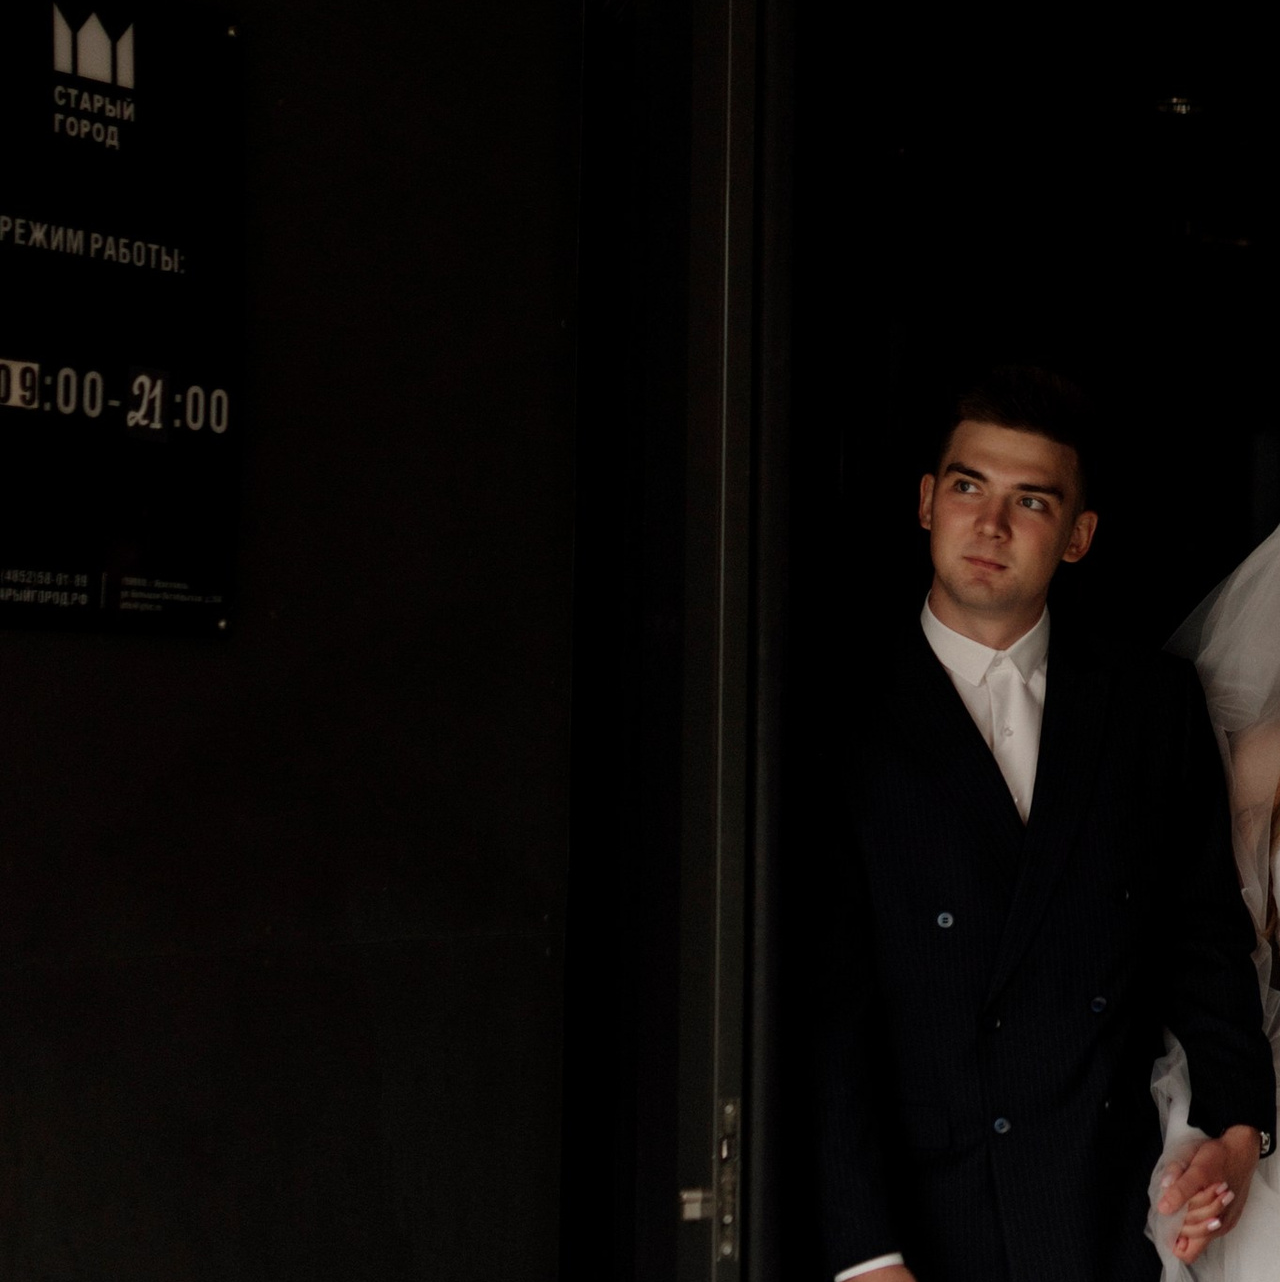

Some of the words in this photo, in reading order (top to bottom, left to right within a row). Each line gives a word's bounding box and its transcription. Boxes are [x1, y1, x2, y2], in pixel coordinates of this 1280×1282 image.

[53, 84, 136, 122] СТАРЫЙ
[53, 113, 120, 150] ГОРОД
[0, 215, 84, 256] РЕЖИМ
[90, 232, 186, 274] РАБОТЫ:
